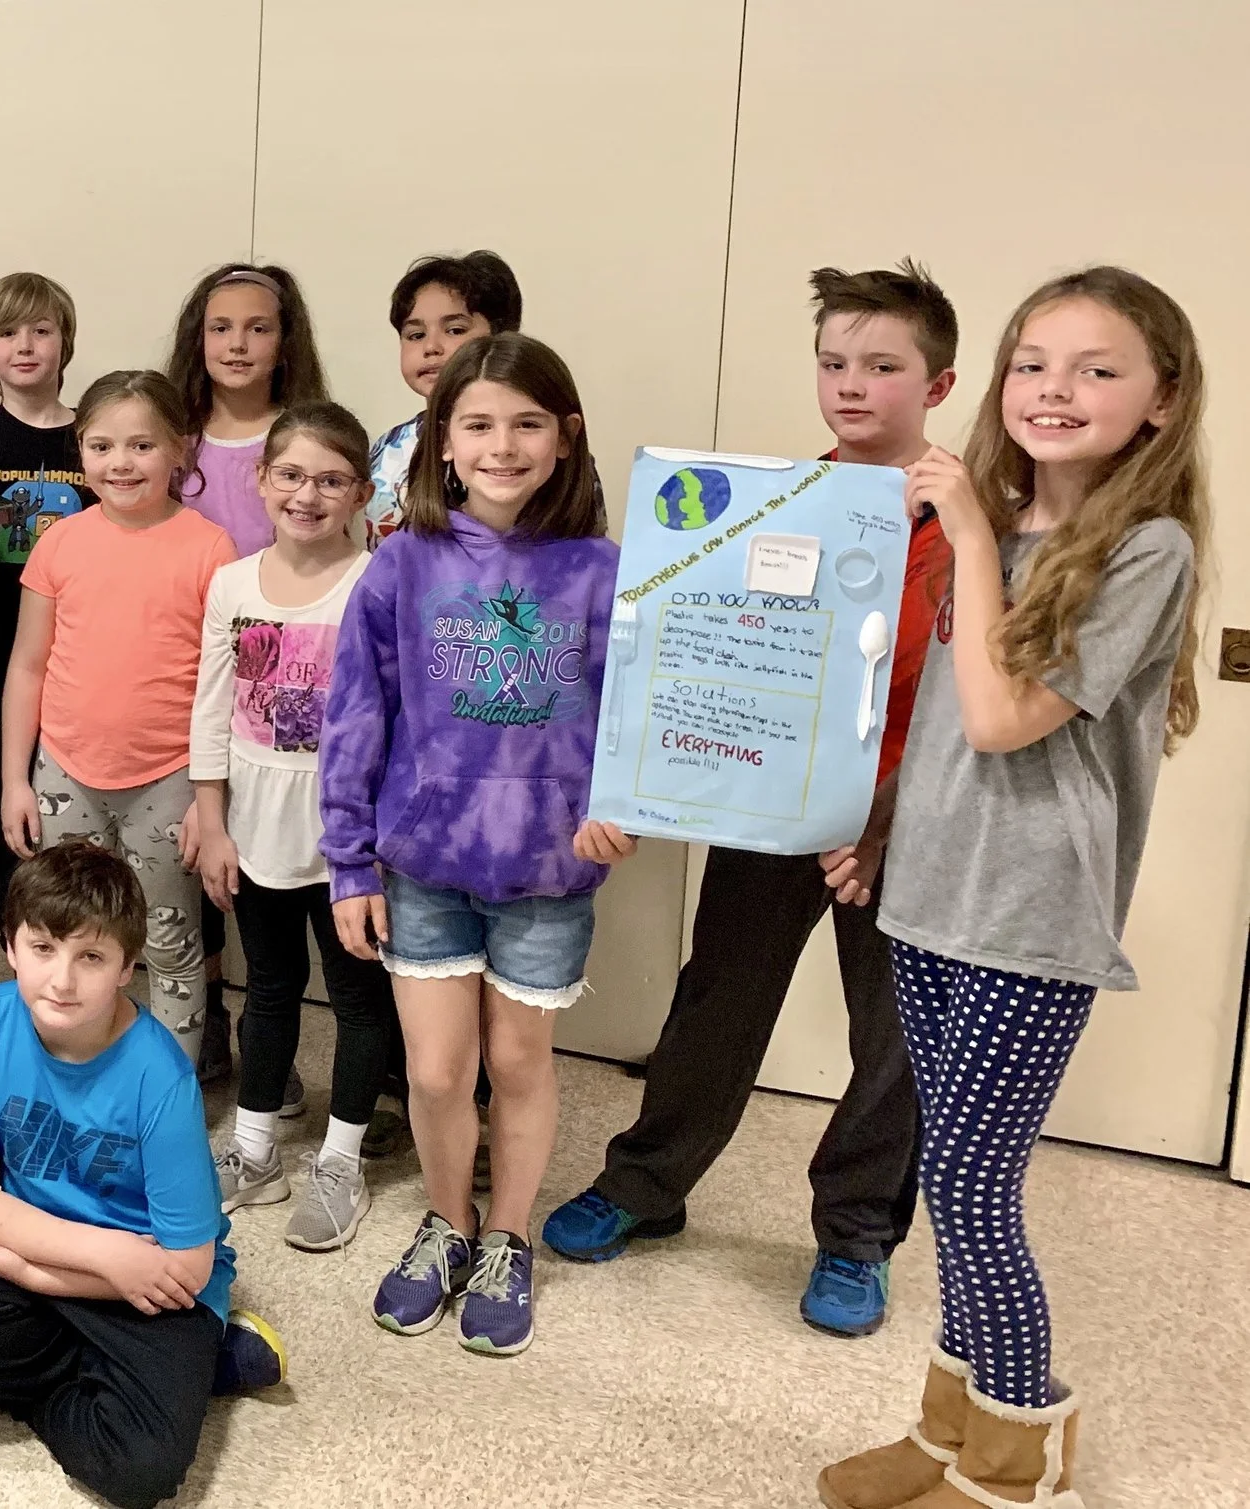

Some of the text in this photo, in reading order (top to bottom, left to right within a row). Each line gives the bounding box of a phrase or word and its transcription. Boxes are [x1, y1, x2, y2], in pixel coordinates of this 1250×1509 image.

[617, 563, 683, 603] TOGETHER
[703, 536, 724, 554] CAN
[726, 509, 766, 540] CHANGE
[765, 493, 787, 511] THE
[671, 592, 820, 612] DID YOU KNOW?
[433, 617, 501, 642] SUSAN
[665, 609, 814, 636] Plastic takes 450 years to
[675, 637, 691, 648] the
[693, 640, 715, 656] food
[286, 661, 317, 683] OF
[670, 679, 757, 709] Solutions
[451, 689, 561, 728] Invitational
[661, 728, 763, 766] EVERYTHING
